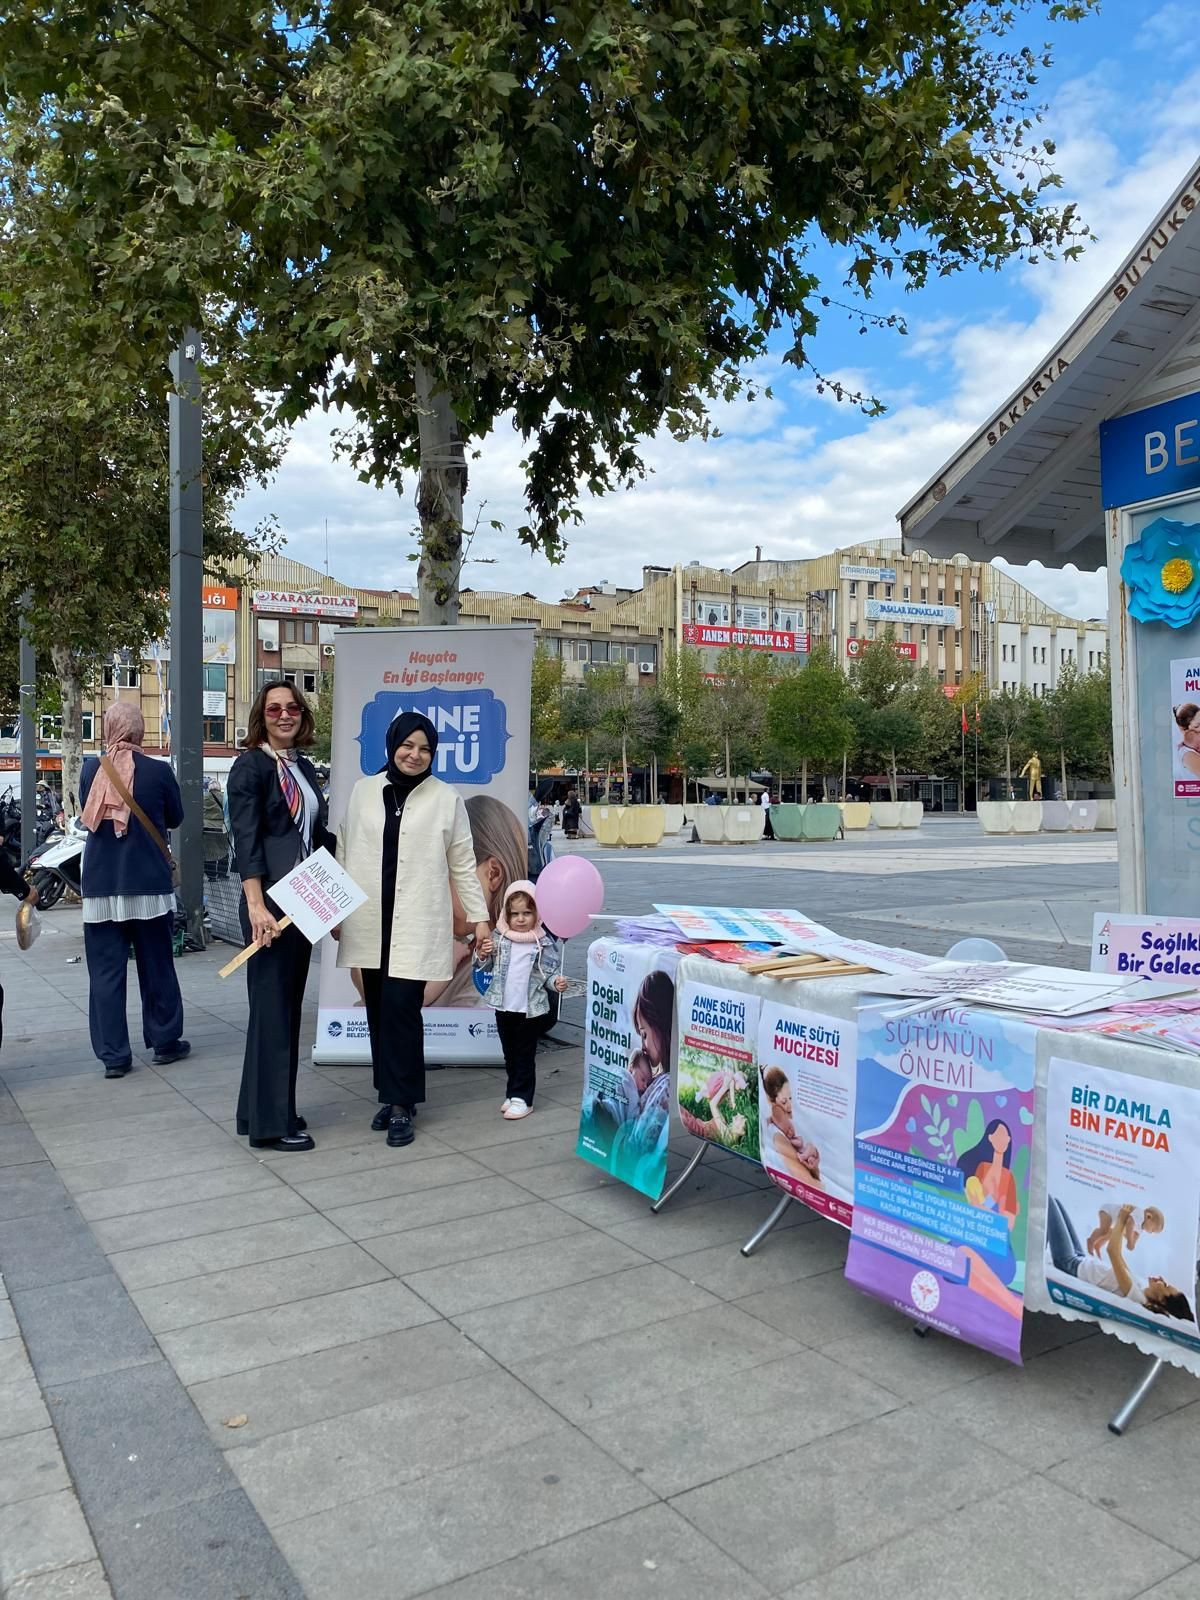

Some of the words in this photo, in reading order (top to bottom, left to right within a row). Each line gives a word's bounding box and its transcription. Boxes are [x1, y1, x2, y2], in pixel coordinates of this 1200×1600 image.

[987, 357, 1069, 446] SAKARYA
[270, 592, 356, 607] KARAKADILAR
[701, 629, 730, 643] JANEM
[409, 651, 458, 666] Hayata
[383, 671, 400, 684] En
[402, 668, 418, 686] İyi
[420, 670, 485, 686] Başlangıç
[306, 861, 333, 888] ANNE
[326, 882, 353, 909] SÜTÜ
[289, 876, 333, 924] GÜÇLENDİRİR
[1118, 952, 1145, 972] Bir
[592, 980, 624, 1005] Doğal
[592, 1000, 617, 1023] Olan
[693, 995, 718, 1011] ANNE
[720, 1000, 745, 1018] SÜTÜ
[591, 1020, 631, 1049] Normal
[691, 1009, 745, 1034] DOĞADAKİ
[776, 1019, 807, 1038] ANNE
[809, 1026, 840, 1047] SÜTÜ
[774, 1035, 839, 1067] MUCİZESİ
[886, 1019, 993, 1062] SÜTÜNÜN
[590, 1042, 629, 1068] Doğum
[900, 1049, 973, 1088] ÖNEMİ
[1071, 1084, 1100, 1109] BİR
[1104, 1094, 1171, 1128] DAMLA
[1070, 1106, 1100, 1133] BİN
[1105, 1117, 1170, 1152] FAYDA
[870, 1154, 890, 1167] SADECE
[891, 1161, 906, 1172] ANNE
